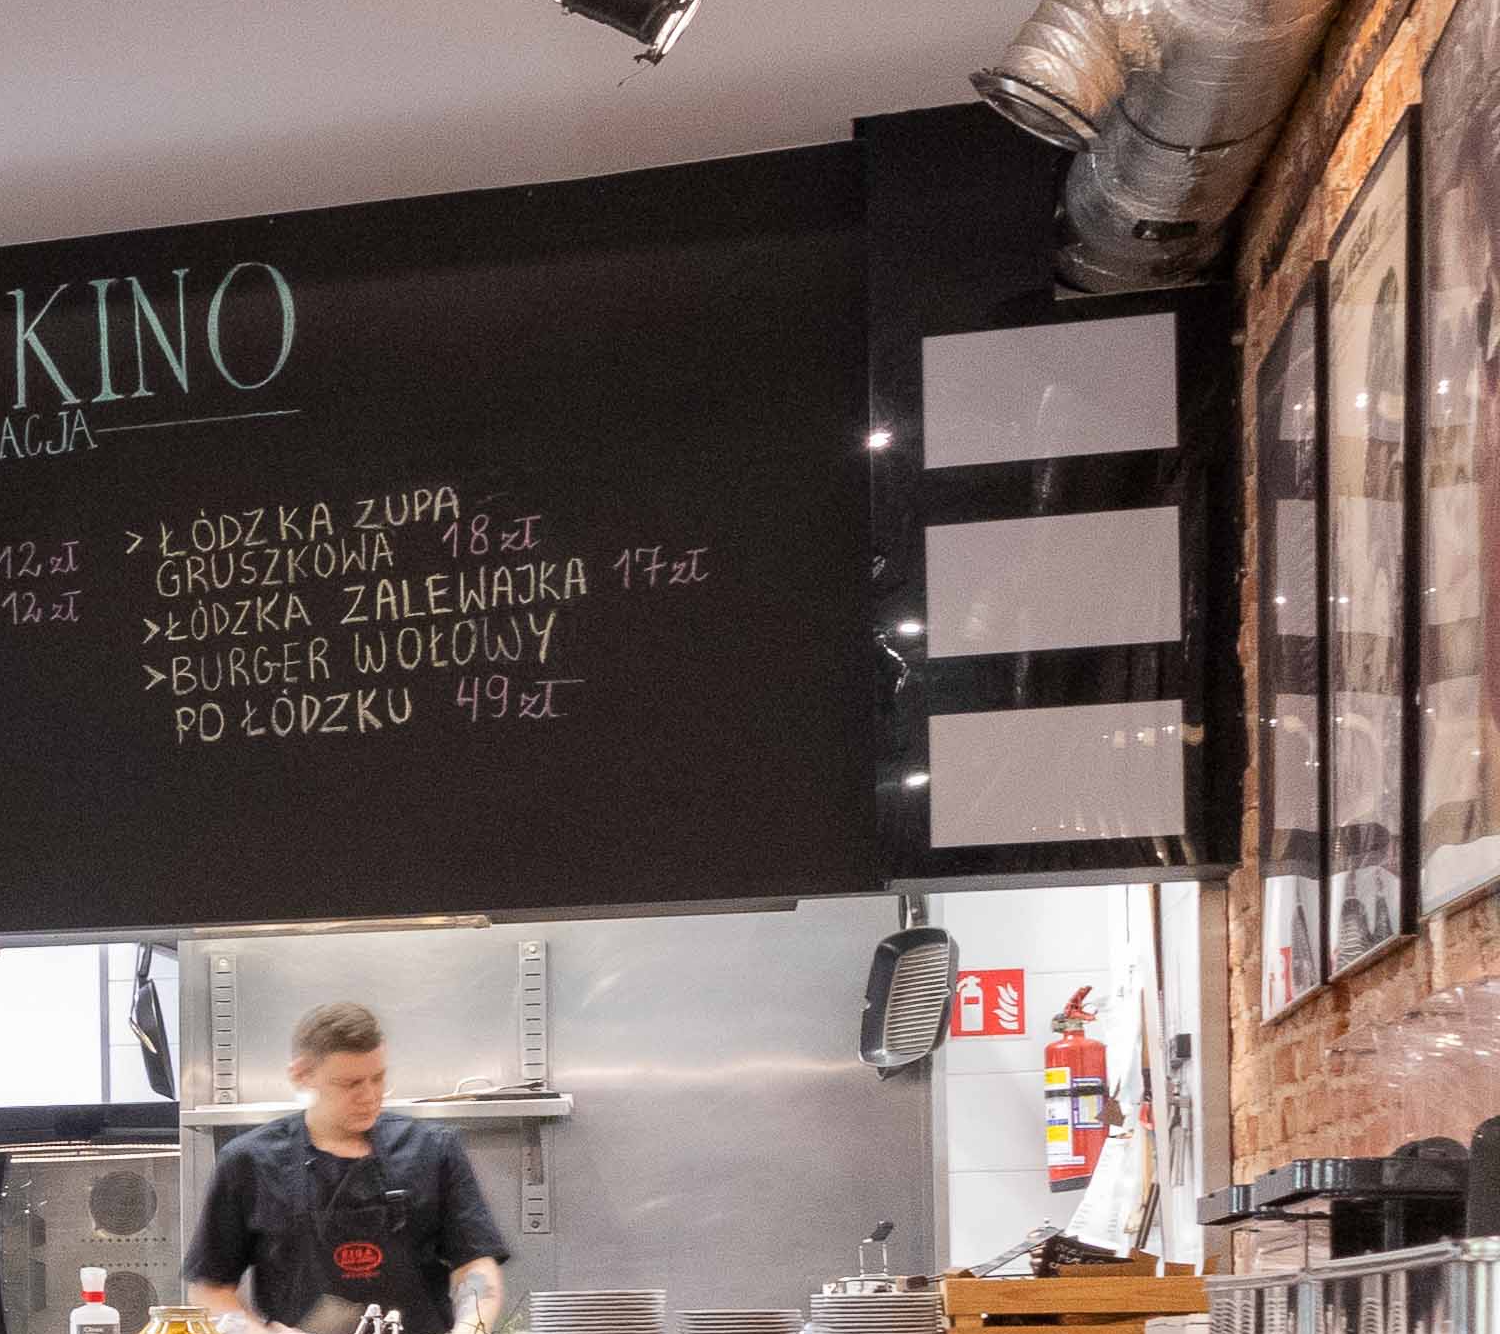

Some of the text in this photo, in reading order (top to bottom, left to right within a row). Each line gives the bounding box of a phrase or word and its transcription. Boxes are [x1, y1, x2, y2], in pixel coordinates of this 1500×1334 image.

[7, 261, 297, 409] KINO
[156, 532, 395, 597] GRUSZKOWA
[441, 514, 490, 558] 18
[159, 485, 461, 559] ŁÓDZKA ZUPA
[1, 591, 43, 625] 12
[340, 557, 588, 624] ZALEWAJKA
[612, 546, 664, 589] 17
[172, 610, 557, 697] BURGER WOŁOWY
[175, 701, 225, 745] PO
[240, 687, 412, 738] ŁÓDZKU
[456, 674, 509, 723] 49
